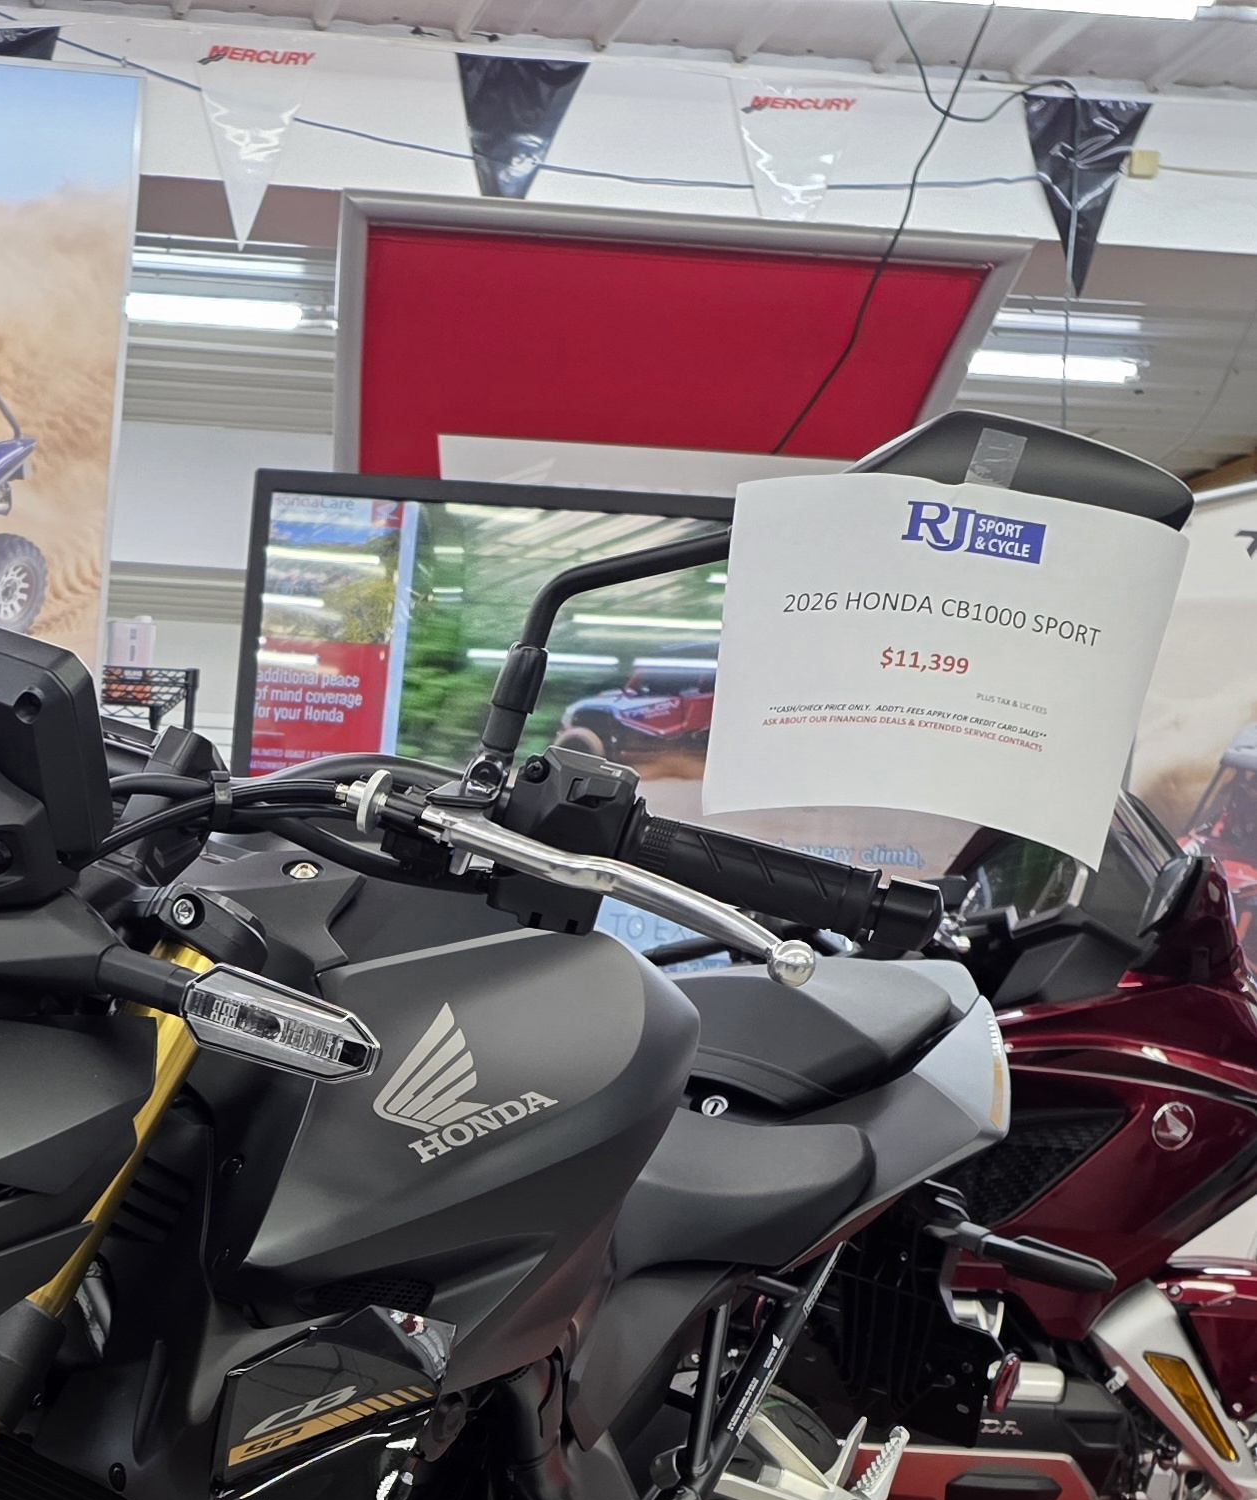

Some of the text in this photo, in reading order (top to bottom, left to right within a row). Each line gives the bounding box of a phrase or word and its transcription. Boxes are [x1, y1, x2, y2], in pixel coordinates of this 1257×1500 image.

[208, 45, 317, 65] MERCURY
[749, 96, 857, 111] MERCURY
[901, 501, 976, 551] RJ
[978, 518, 1024, 539] SPORT
[974, 536, 1031, 558] & CYCLE
[783, 592, 1101, 647] 2026 HONDA CB1000 SPORT
[880, 646, 969, 675] $11,399
[321, 674, 360, 688] peace
[270, 687, 302, 703] mind
[305, 691, 363, 709] coverage
[976, 692, 995, 703] PLUS
[997, 696, 1011, 706] TAX
[1019, 701, 1031, 711] LIC
[1031, 704, 1047, 715] FEES
[254, 702, 344, 723] for your Honda
[824, 703, 847, 711] PRICE
[848, 704, 871, 712] ONLY.
[906, 706, 925, 715] FEES
[926, 709, 952, 719] APPLY
[952, 713, 968, 722] FOR
[969, 716, 997, 728] CREDIT
[997, 722, 1018, 733] CARD
[779, 716, 807, 725] ABOUT
[809, 715, 828, 723] OUR
[829, 715, 877, 724] FINANCING
[878, 716, 906, 726] DEALS
[918, 720, 962, 733] EXTENDED
[964, 727, 996, 740] SERVICE
[998, 734, 1043, 752] CONTRACTS
[408, 1091, 559, 1164] HONDA
[244, 1385, 358, 1440] CB
[239, 1426, 305, 1459] SP
